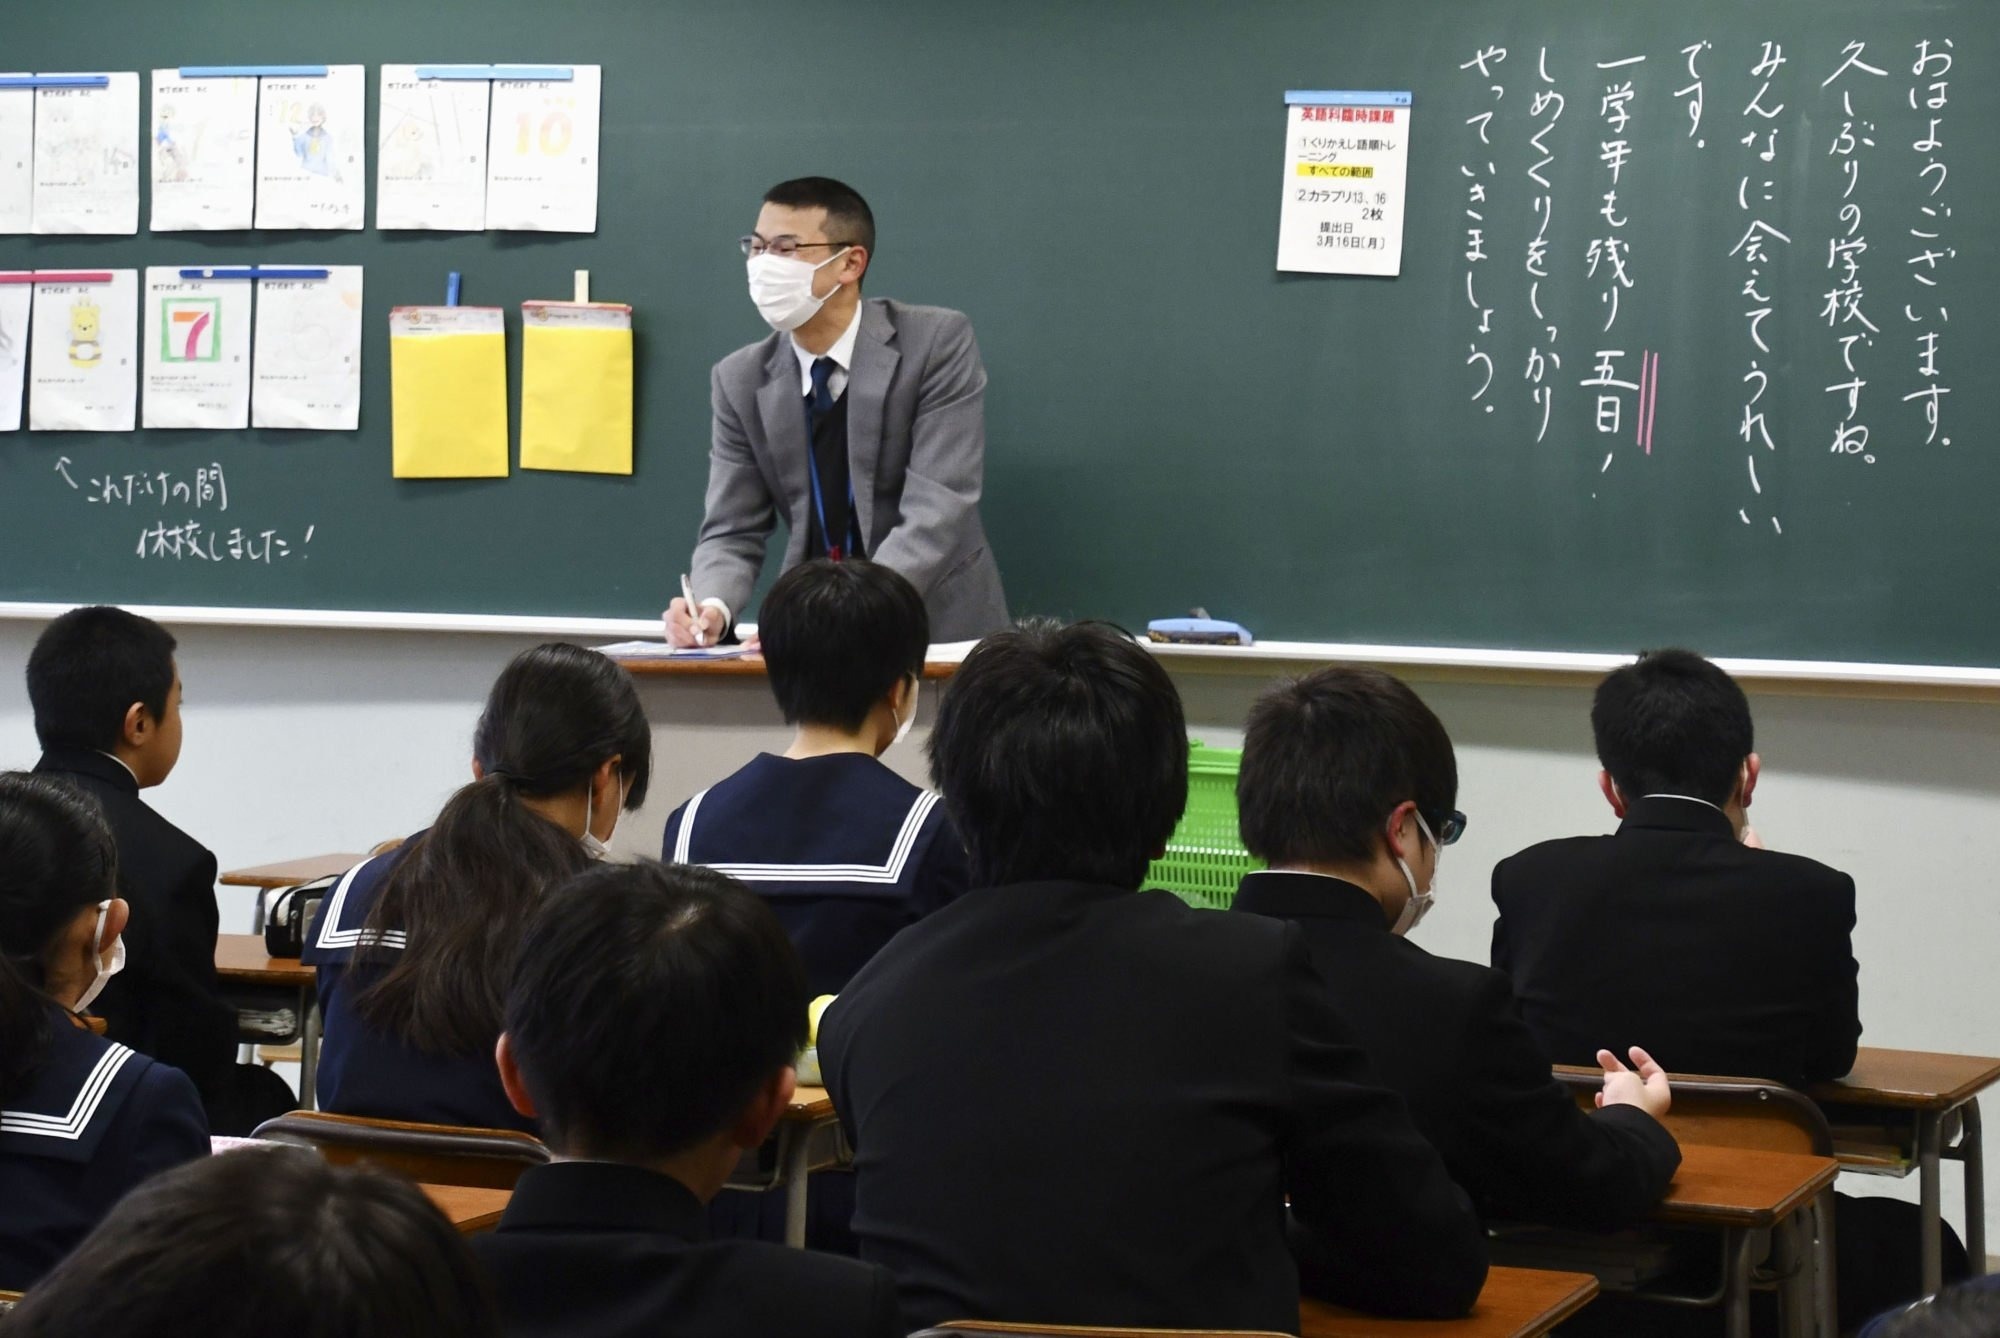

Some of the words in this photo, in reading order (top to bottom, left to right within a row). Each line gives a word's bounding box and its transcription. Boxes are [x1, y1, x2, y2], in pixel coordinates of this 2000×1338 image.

[1301, 107, 1395, 123] 英語科臨時課題
[1673, 39, 1713, 149] です。
[515, 110, 573, 157] 10
[1298, 151, 1337, 163] ーニング
[1309, 165, 1374, 179] すべての範囲
[1320, 221, 1354, 234] 提出日
[1361, 207, 1384, 221] 2枚
[1459, 44, 1507, 413] やっていきましょう。
[1524, 46, 1565, 443] しめくくりをしっかり
[1820, 39, 1889, 464] 久しぶりの学校ですね。
[1902, 38, 1956, 446] おはようございます。
[1728, 40, 1792, 534] みんなに会えてうれしい
[173, 311, 210, 361] 7
[87, 462, 228, 511] これだけの間
[136, 519, 315, 564] 休校しました!
